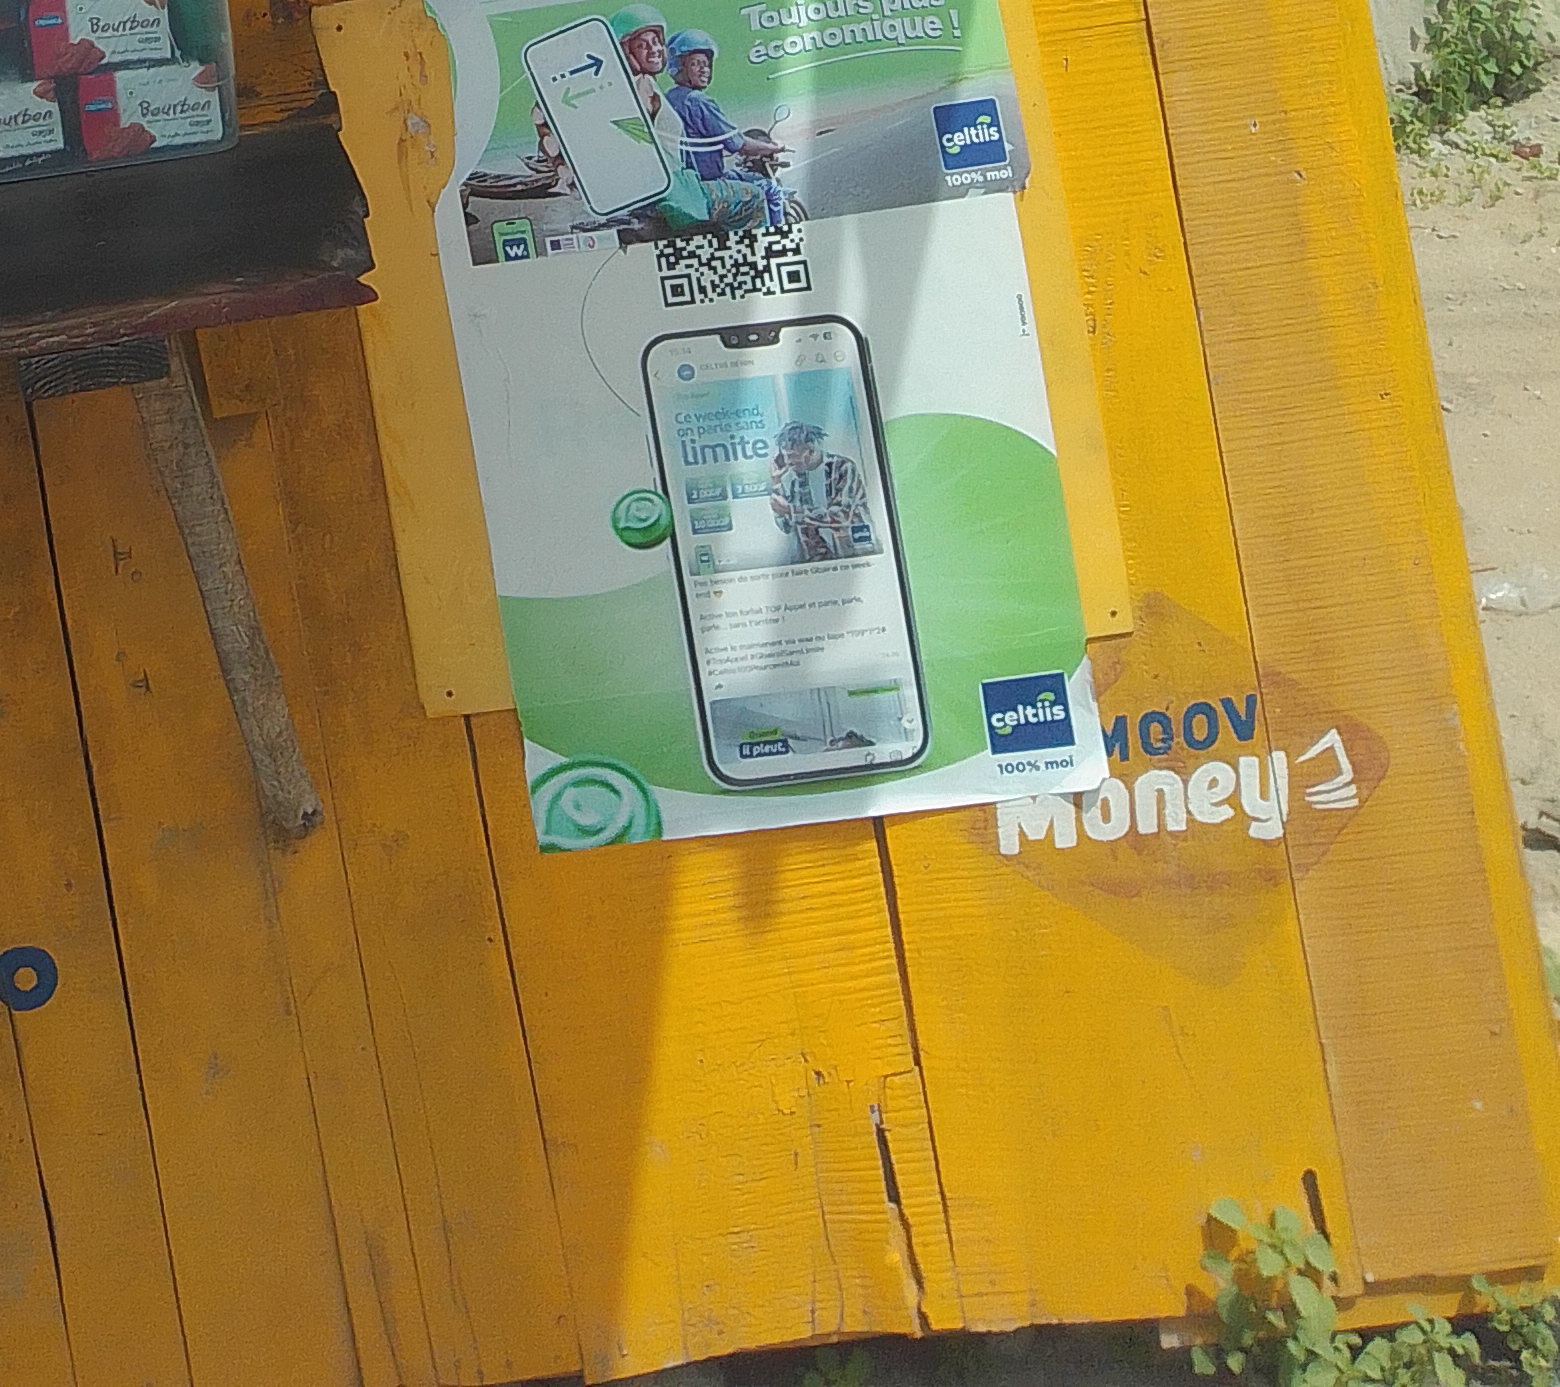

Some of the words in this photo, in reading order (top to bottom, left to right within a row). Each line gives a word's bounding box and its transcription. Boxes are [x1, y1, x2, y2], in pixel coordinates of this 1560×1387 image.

[89, 13, 162, 35] Bourbon
[748, 9, 943, 65] économique
[950, 10, 961, 37] !
[138, 97, 213, 119] Bourbon
[942, 120, 1000, 152] celtiis
[944, 169, 984, 189] 100%
[987, 165, 1013, 183] moi
[681, 434, 769, 466] limite
[990, 701, 1065, 731] celtiis
[1101, 693, 1257, 762] MOOV
[997, 757, 1040, 776] 100%
[1043, 754, 1074, 772] moi
[996, 750, 1288, 855] Money
